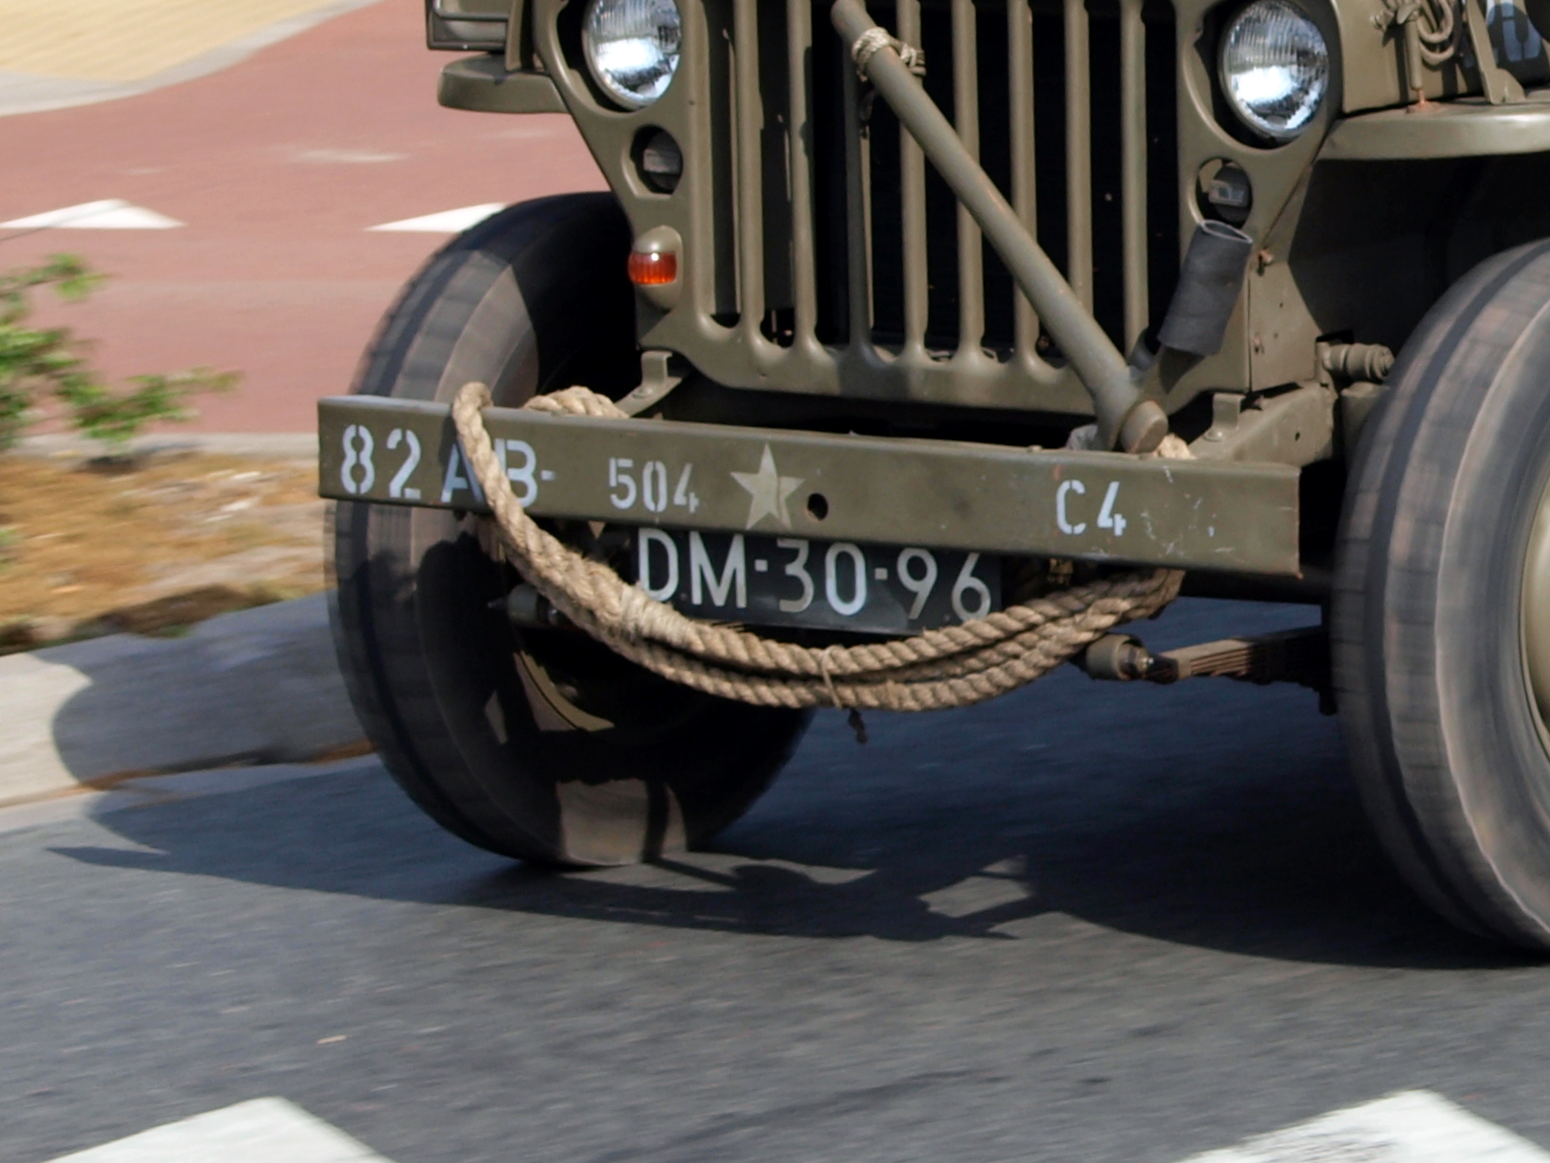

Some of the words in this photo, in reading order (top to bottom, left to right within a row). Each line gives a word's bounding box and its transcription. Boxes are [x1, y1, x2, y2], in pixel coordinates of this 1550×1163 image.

[608, 457, 700, 513] 504
[1056, 479, 1127, 537] C4
[637, 527, 992, 622] DM-30-96
